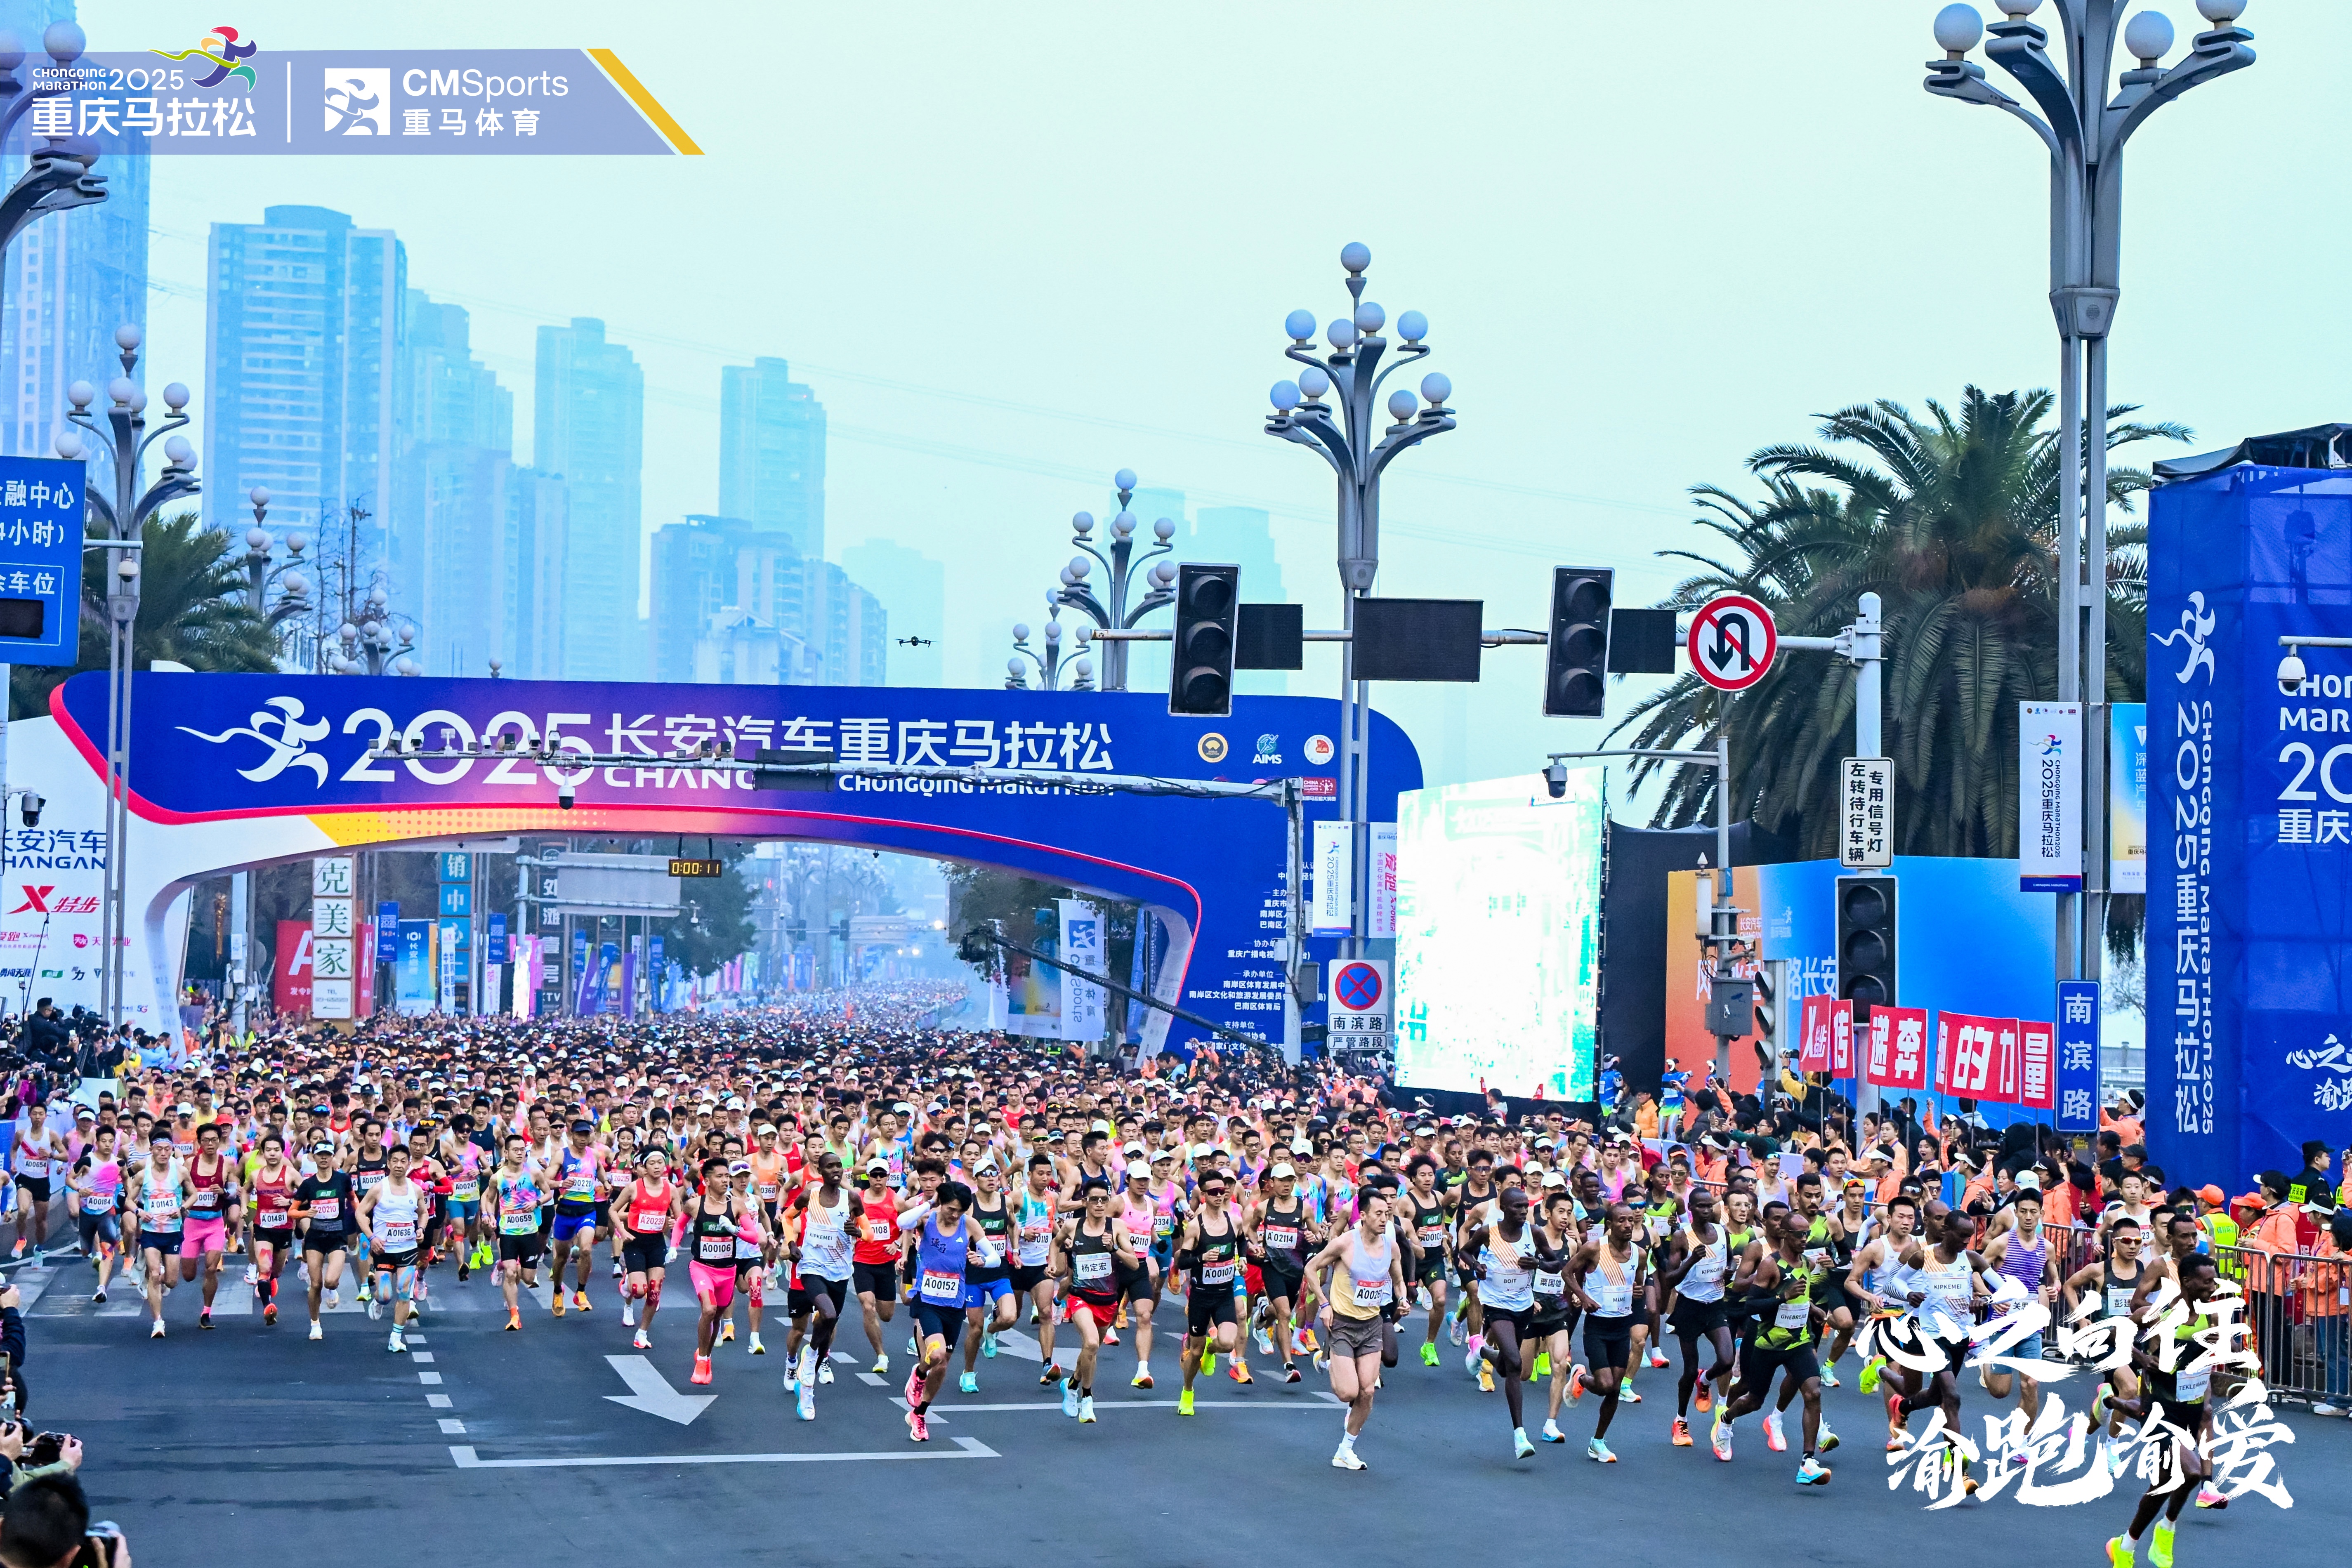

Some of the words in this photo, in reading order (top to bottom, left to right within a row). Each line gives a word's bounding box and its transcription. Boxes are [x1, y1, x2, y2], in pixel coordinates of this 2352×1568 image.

[0, 480, 74, 509] 融中心
[340, 708, 594, 787] 2025
[1253, 754, 1282, 764] AIMS
[1848, 763, 1866, 862] 左转待行车辆
[1867, 771, 1884, 853] 专用信号灯
[672, 863, 719, 874] 0:00:11
[52, 896, 101, 913] 特步
[317, 863, 349, 975] 克美家
[1223, 981, 1285, 989] 南岸区体育发展中
[543, 993, 561, 1002] TV
[1234, 1002, 1281, 1011] 巴南区体育局
[1333, 1016, 1383, 1031] 南滨路
[1332, 1036, 1383, 1048] 严管路段
[2063, 993, 2094, 1121] 南滨路
[2286, 1034, 2352, 1073] 心之
[25, 1159, 47, 1168] A00654
[455, 1181, 477, 1190] A00243
[151, 1199, 173, 1209] A01143
[318, 1205, 337, 1214] 20210
[262, 1214, 285, 1223] A01481
[507, 1215, 532, 1224] A00659
[640, 1217, 665, 1225] A20239
[387, 1228, 411, 1237] A01636
[872, 1226, 888, 1234] 0108
[809, 1233, 833, 1241] KIPKEMEI
[1130, 1236, 1149, 1246] 00110
[1267, 1232, 1293, 1243] A02114
[702, 1244, 731, 1253] A00106
[1081, 1262, 1107, 1272] 杨定宏
[1205, 1267, 1232, 1278] A00107
[924, 1278, 955, 1291] A00152
[2114, 1299, 2131, 1308] 彭建
